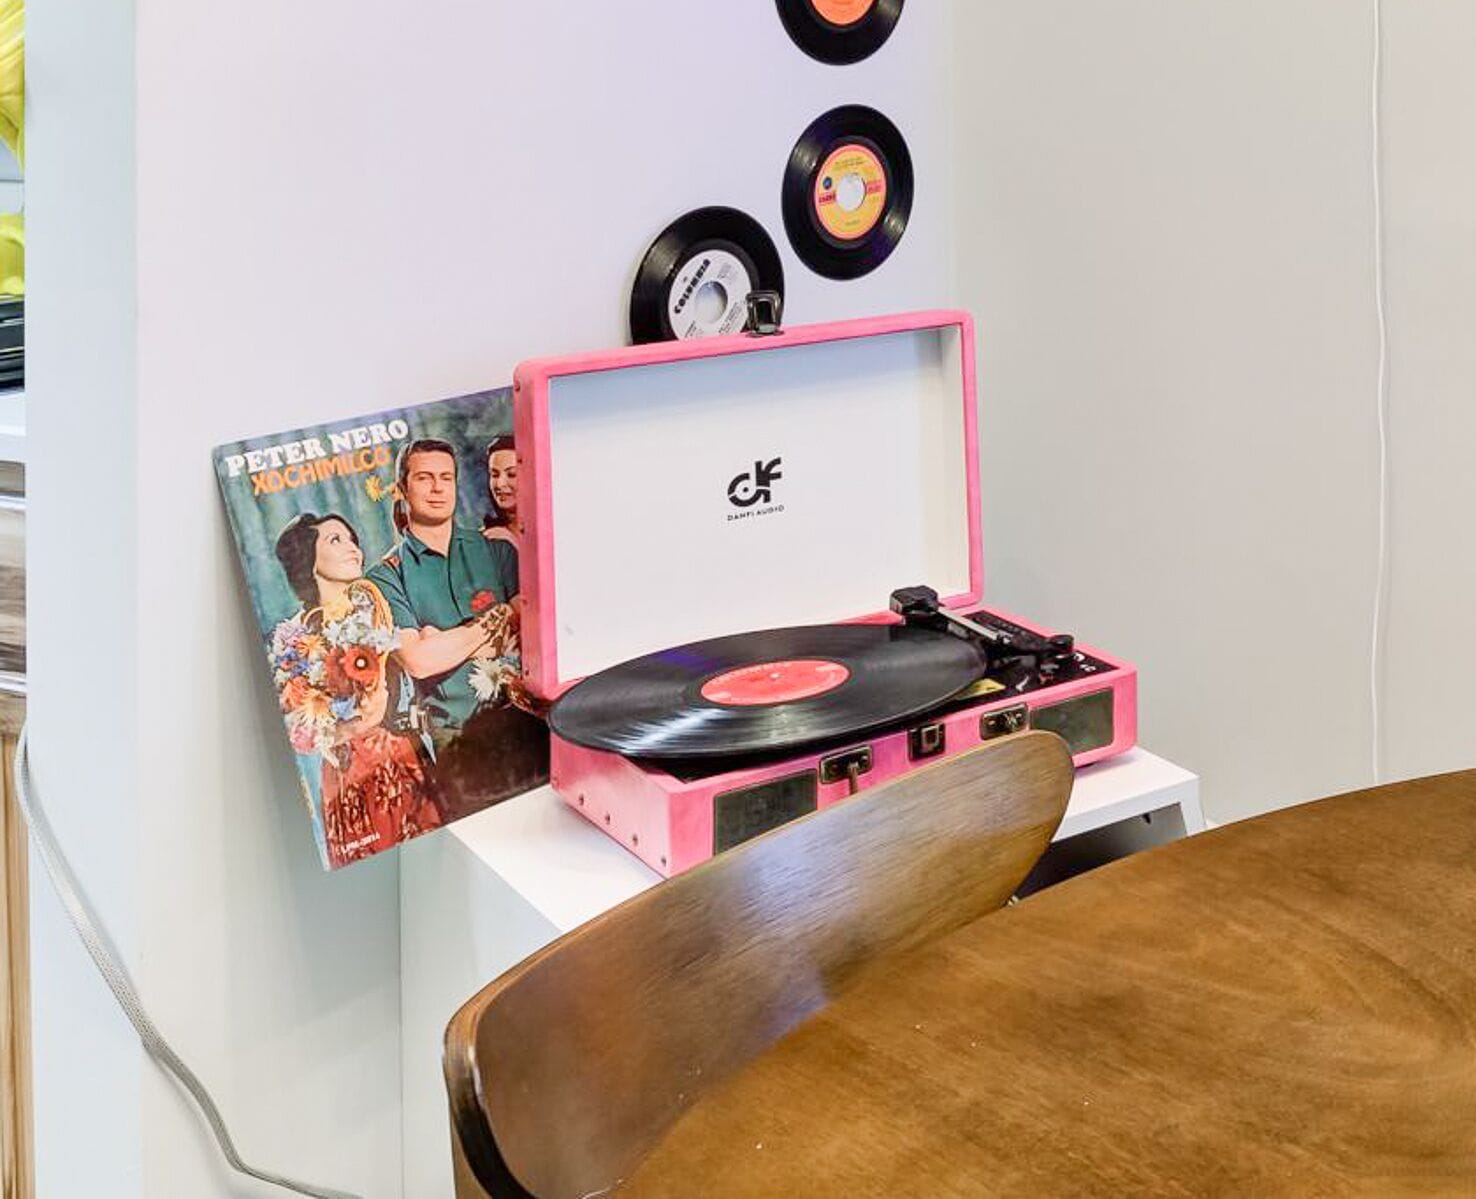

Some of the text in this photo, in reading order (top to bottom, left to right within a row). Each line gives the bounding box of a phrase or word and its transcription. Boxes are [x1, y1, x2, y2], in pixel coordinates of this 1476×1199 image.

[225, 419, 409, 477] PETER NERO
[251, 445, 391, 496] XOCHIMILCO
